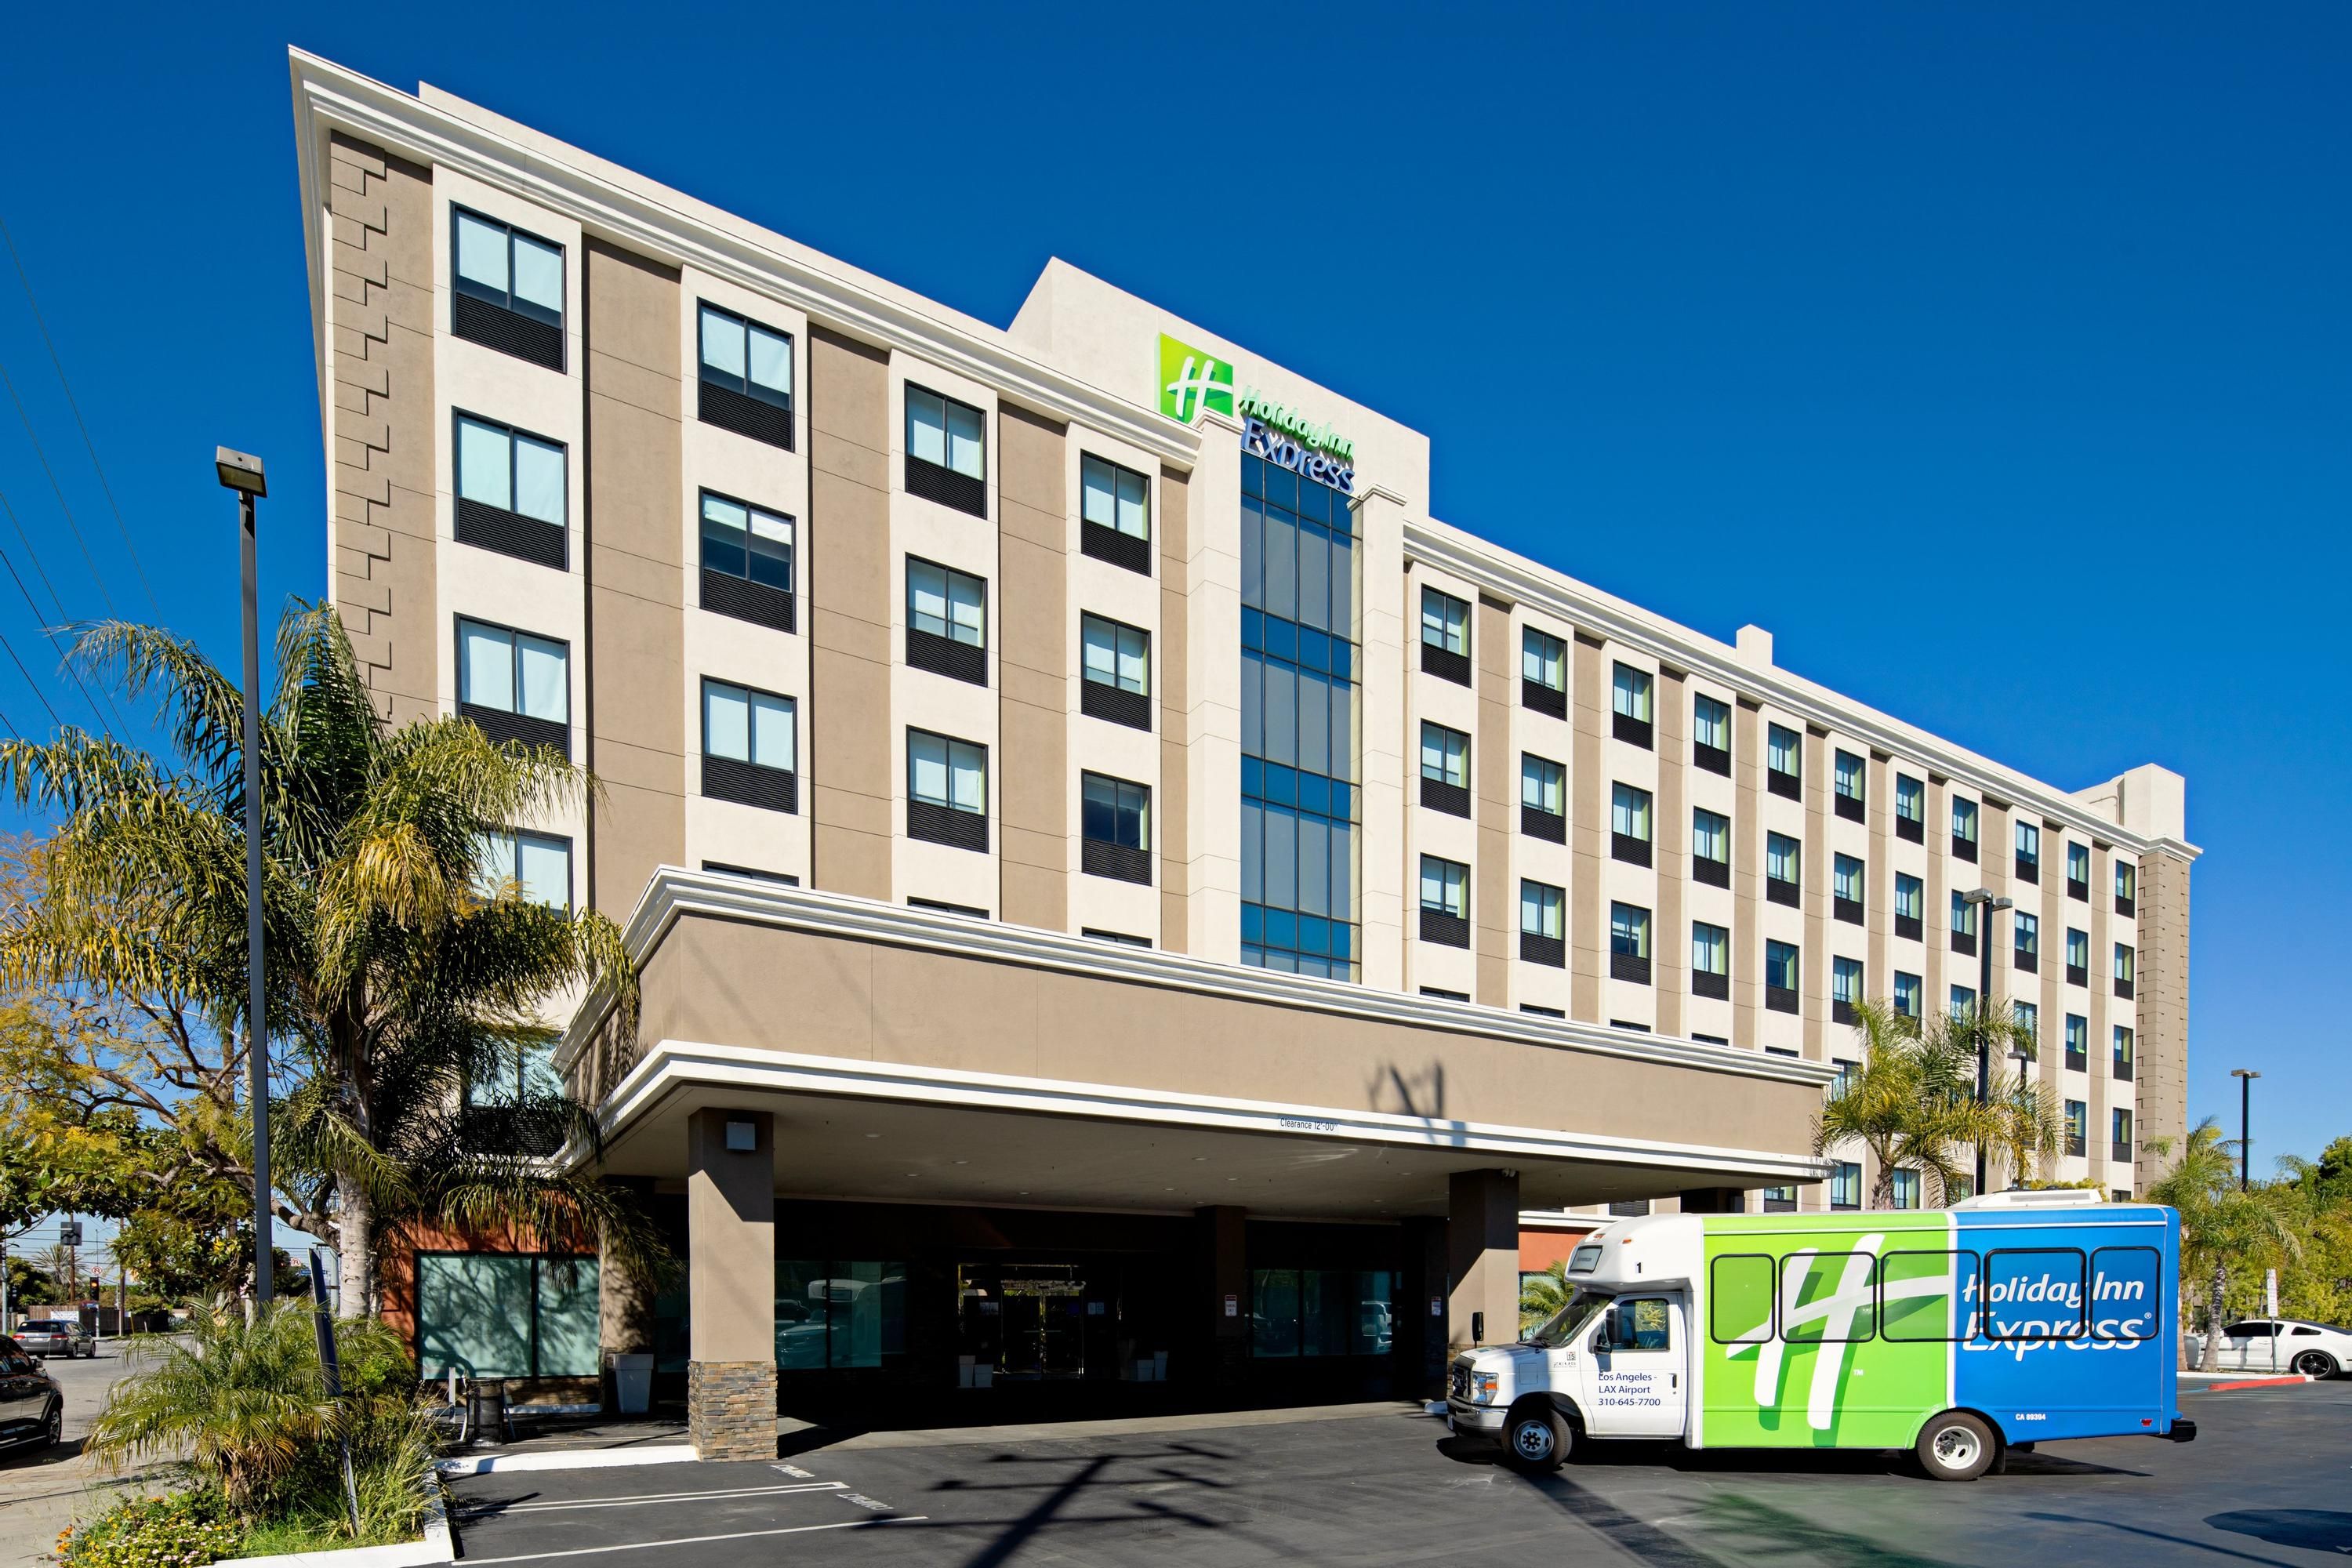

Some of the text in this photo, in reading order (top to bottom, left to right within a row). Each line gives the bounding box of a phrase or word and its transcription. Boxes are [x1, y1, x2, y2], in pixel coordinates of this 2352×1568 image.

[1239, 385, 1356, 460] Holiday Inn
[1241, 416, 1356, 495] Express
[1280, 1117, 1312, 1129] Clearance
[1636, 1261, 1642, 1273] 1
[1962, 1271, 2144, 1308] Holiday Inn
[1962, 1311, 2144, 1362] Express
[1615, 1373, 1652, 1383] Angeles
[1599, 1385, 1650, 1396] LAX Airport
